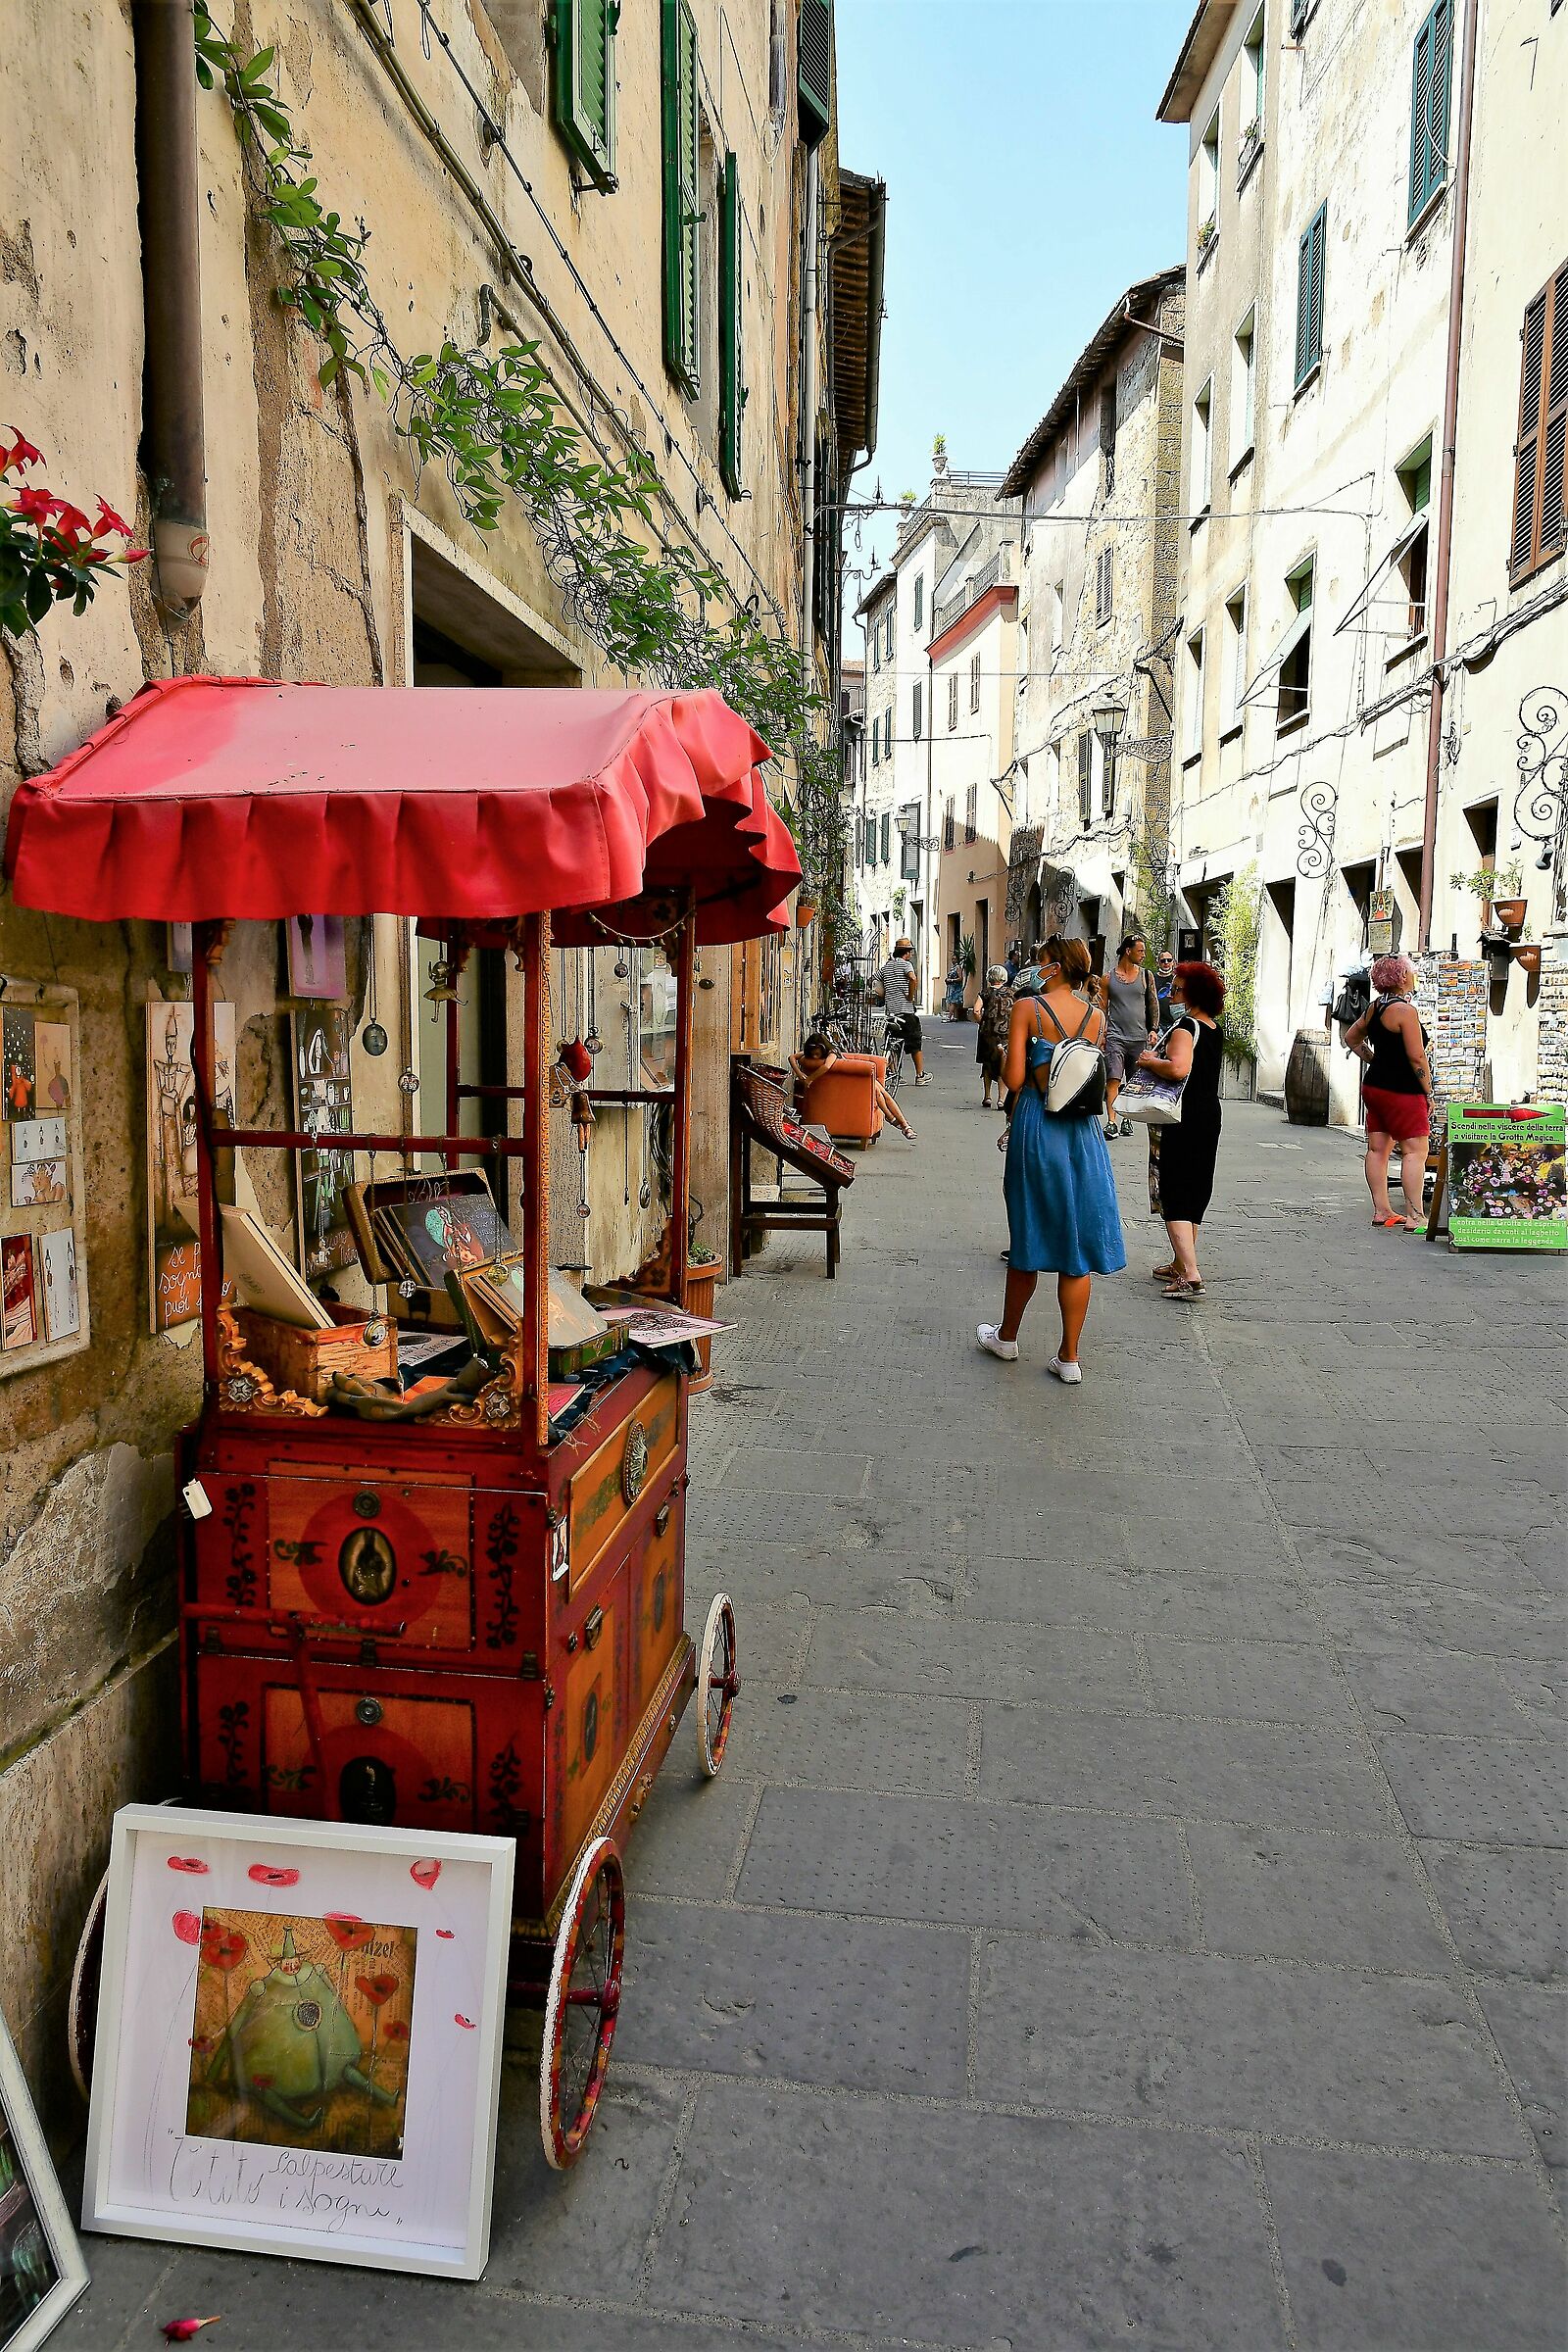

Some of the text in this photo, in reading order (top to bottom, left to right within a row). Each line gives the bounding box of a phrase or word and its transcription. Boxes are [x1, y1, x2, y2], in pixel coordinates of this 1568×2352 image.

[1450, 1121, 1477, 1130] Scendi
[1529, 1229, 1560, 1238] laghetto
[1521, 1237, 1554, 1247] leggenda
